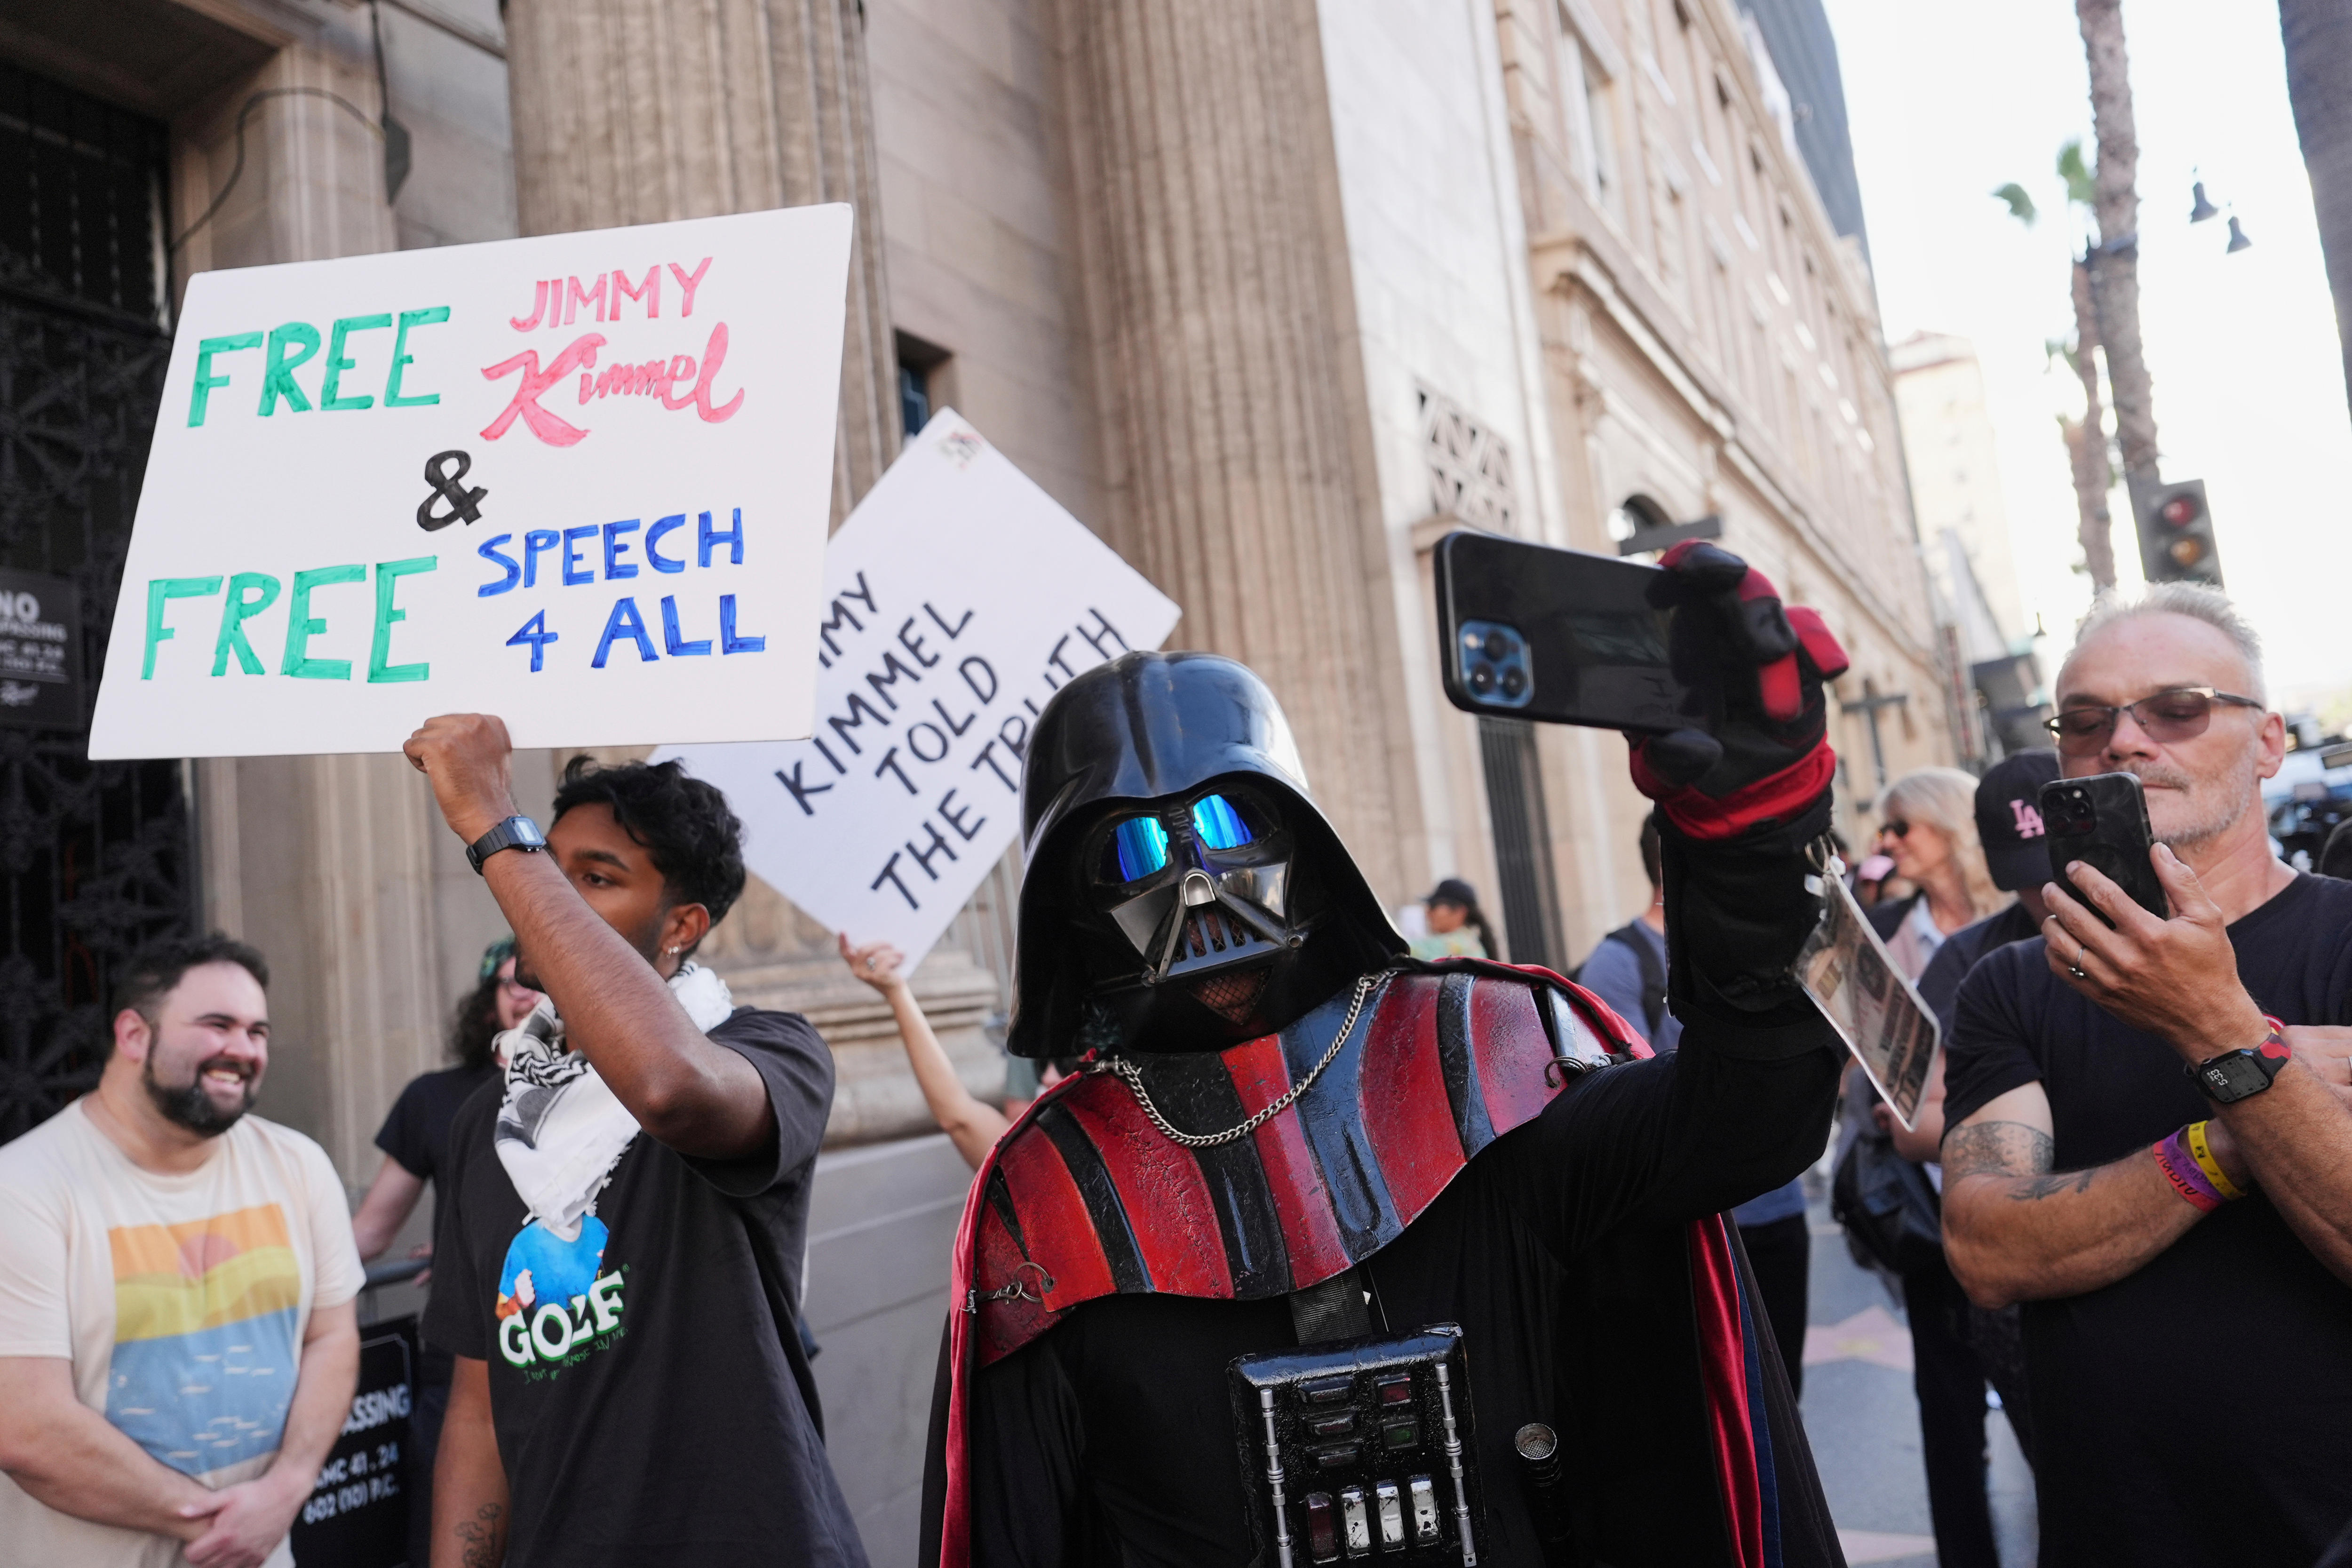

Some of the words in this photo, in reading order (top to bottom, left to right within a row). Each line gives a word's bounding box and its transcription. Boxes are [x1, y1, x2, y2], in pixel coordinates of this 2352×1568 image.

[509, 257, 713, 332] JIMMY
[187, 305, 451, 428] FREE
[479, 321, 744, 447] Kimmel
[416, 450, 488, 532] &
[477, 507, 743, 598] SPEECH
[141, 555, 438, 684] FREE
[506, 609, 559, 673] 4
[591, 593, 766, 669] ALL
[774, 603, 976, 816] KIMMEL
[875, 656, 998, 796] TOLD
[871, 789, 988, 910] THE
[2010, 799, 2045, 838] LA
[2210, 1069, 2228, 1086] 5:33
